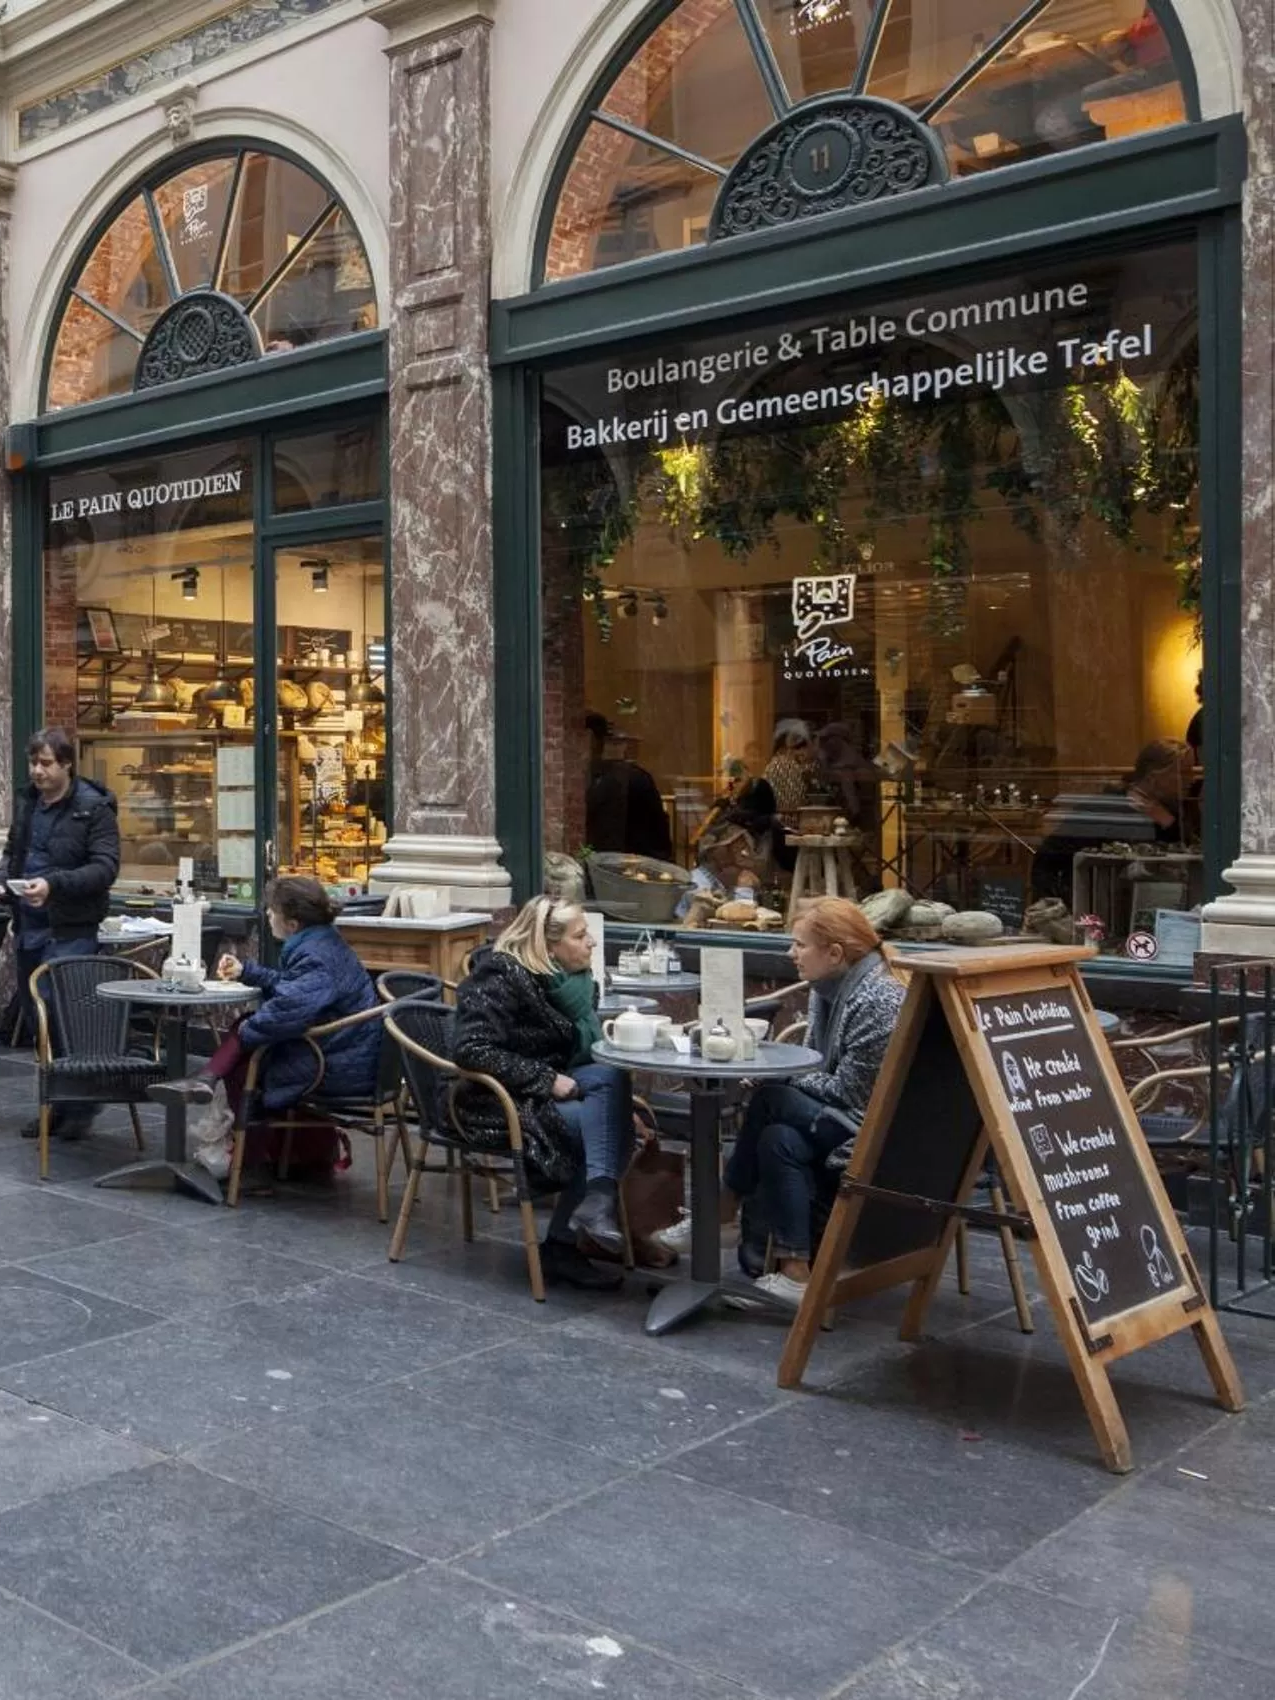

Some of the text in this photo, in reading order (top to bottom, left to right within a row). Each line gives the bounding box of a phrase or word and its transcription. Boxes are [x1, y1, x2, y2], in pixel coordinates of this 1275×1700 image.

[809, 143, 830, 174] 11
[608, 283, 1088, 393] Boulangerie & Table Commune
[567, 324, 1152, 450] Bakkerij en Gemeenschappelijke Tafel
[51, 470, 243, 522] LE PAIN QUOTIDIEN
[794, 637, 854, 668] Pain
[784, 668, 869, 680] QUOTIDIEN
[975, 1001, 1071, 1031] Le Pain Quotidien
[1023, 1048, 1082, 1079] He created
[1062, 1082, 1092, 1102] water
[1054, 1125, 1116, 1157] We created
[1043, 1162, 1110, 1193] mushrooms
[1088, 1192, 1121, 1212] coffee
[1086, 1214, 1120, 1249] grind
